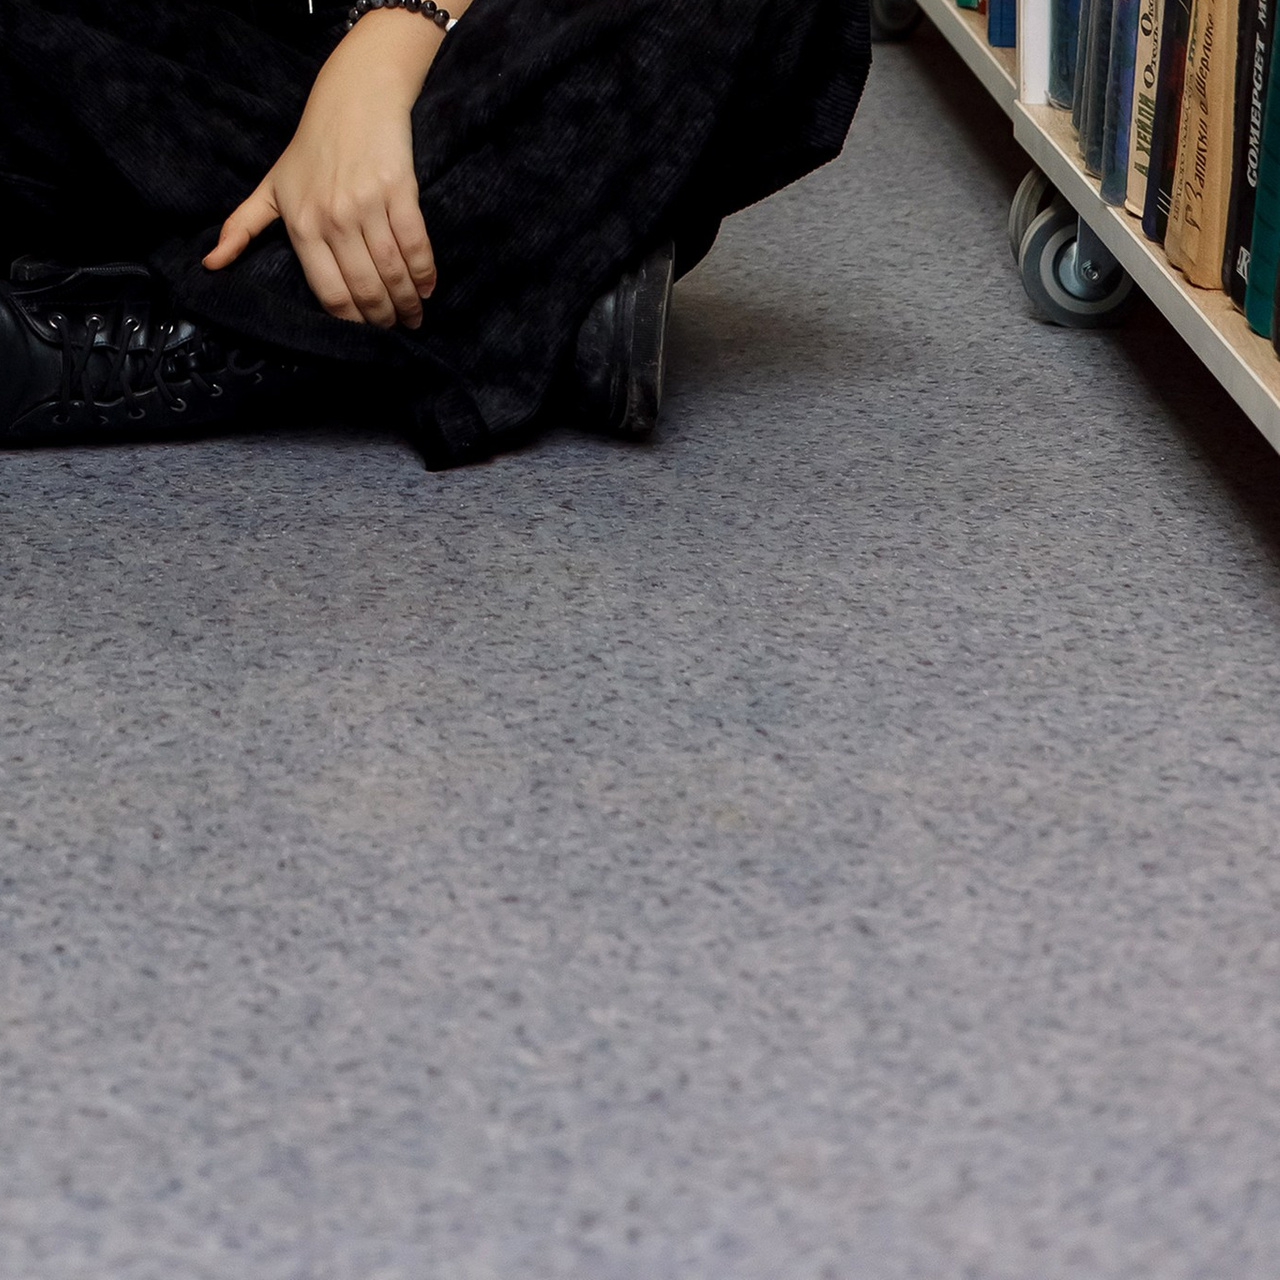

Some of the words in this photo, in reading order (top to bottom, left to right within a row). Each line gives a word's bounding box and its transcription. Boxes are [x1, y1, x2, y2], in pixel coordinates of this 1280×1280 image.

[1143, 25, 1159, 89] Отель
[1194, 12, 1215, 102] Шерлоке
[1134, 91, 1156, 156] ХЕЙЛИ
[1246, 30, 1266, 188] СОМЕРСЕТ
[1184, 118, 1209, 203] Записки
